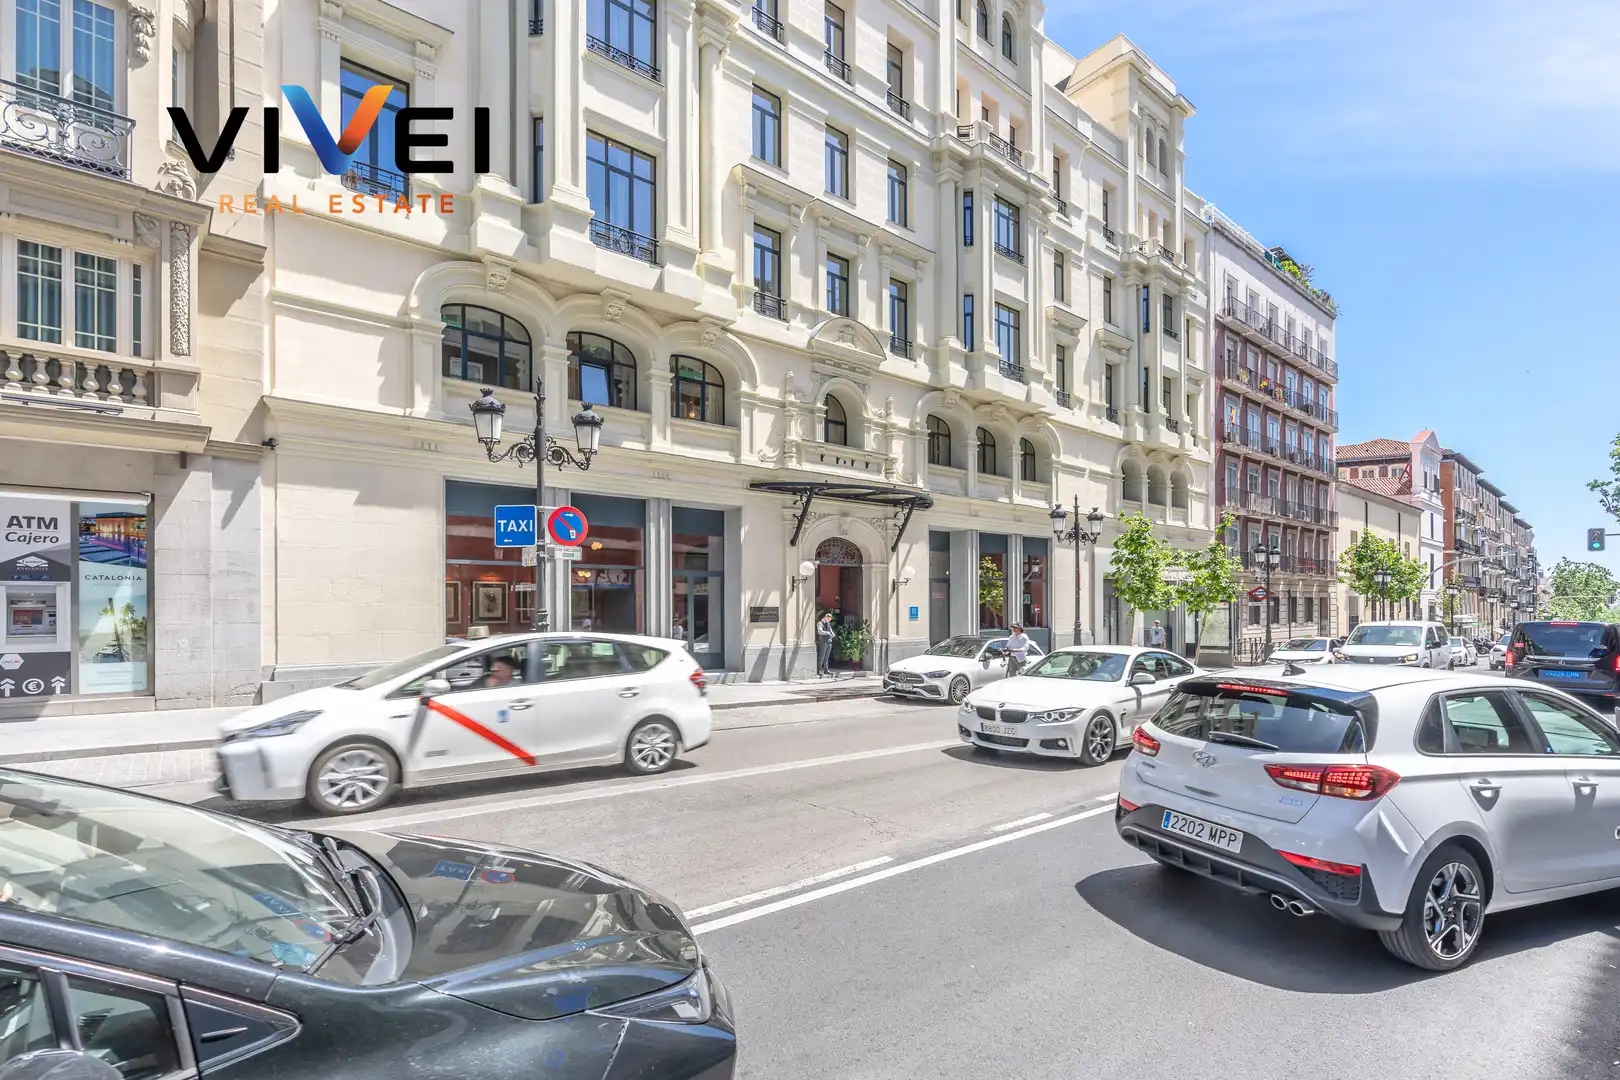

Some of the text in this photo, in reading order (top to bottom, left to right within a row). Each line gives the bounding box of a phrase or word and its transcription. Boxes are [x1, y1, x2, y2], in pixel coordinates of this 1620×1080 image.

[6, 515, 58, 530] ATM
[498, 519, 533, 532] TAXI
[5, 531, 60, 545] Cajero
[1170, 815, 1205, 839] 2202
[1208, 826, 1238, 848] MPP
